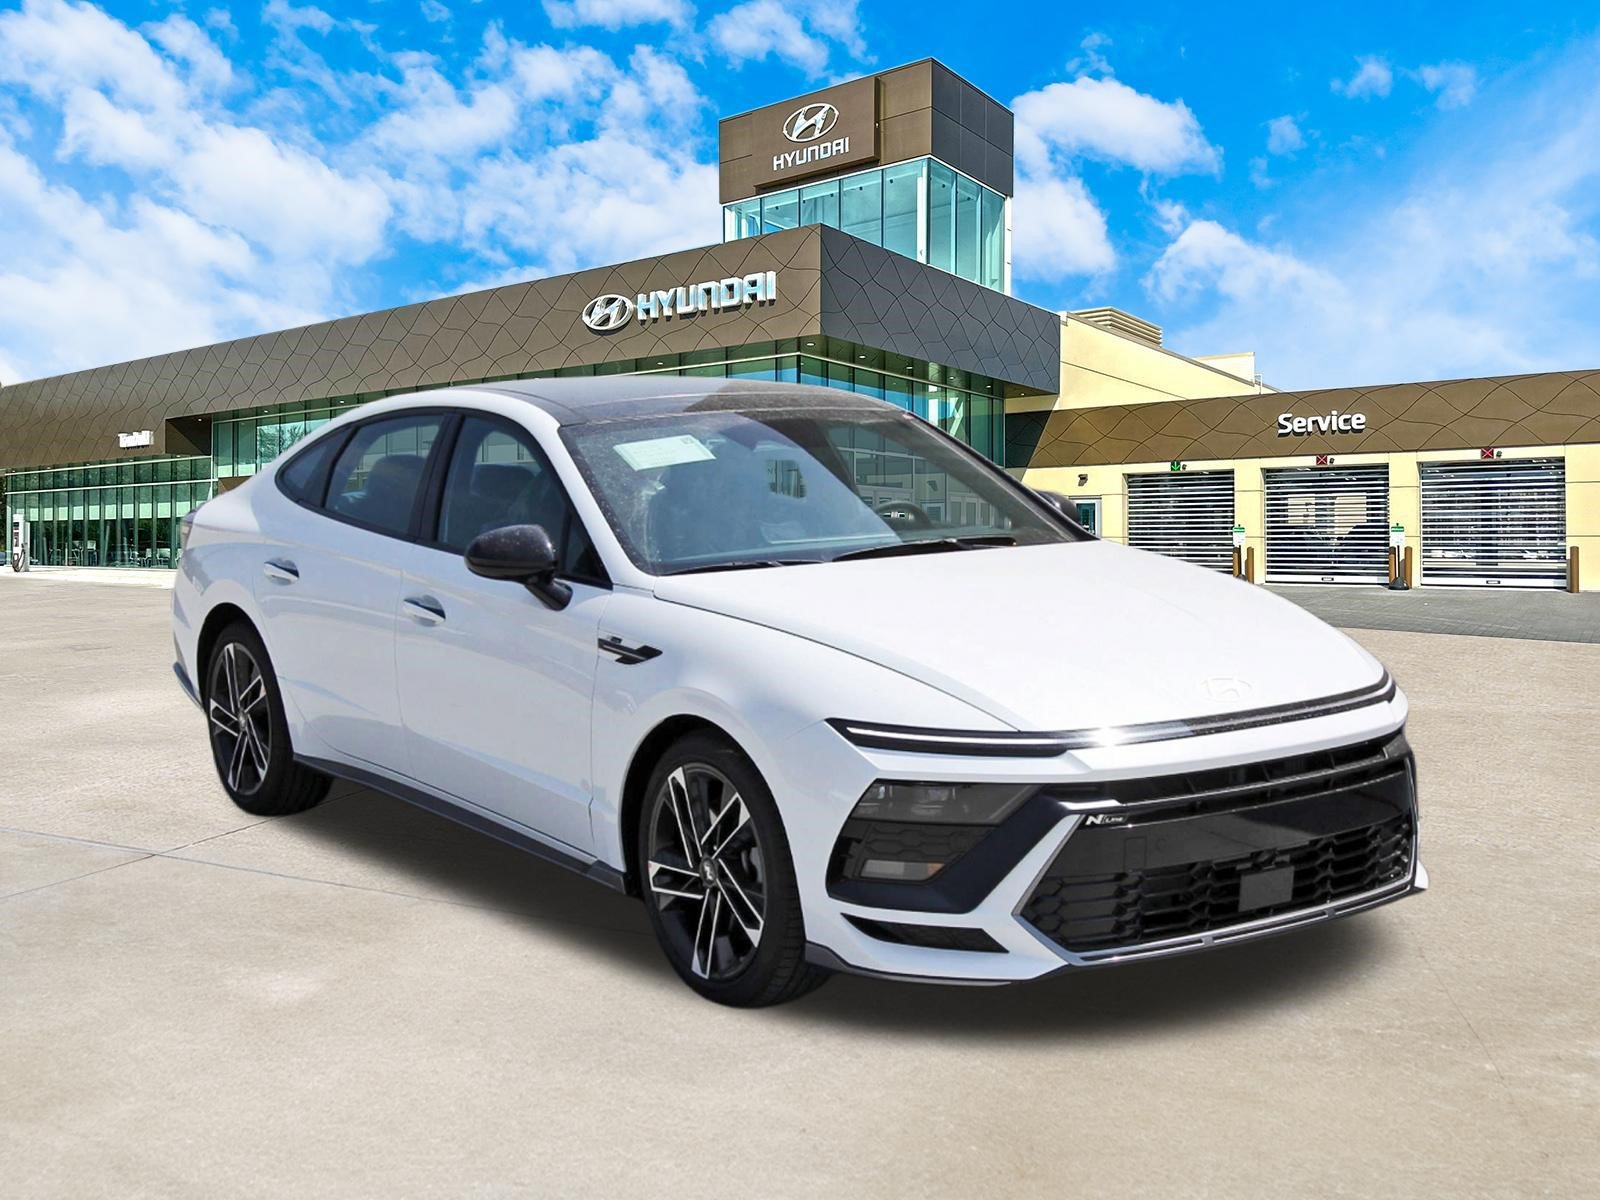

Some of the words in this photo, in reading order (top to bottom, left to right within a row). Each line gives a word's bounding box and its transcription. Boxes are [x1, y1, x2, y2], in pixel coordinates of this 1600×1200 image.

[773, 137, 850, 171] HYUNDAI
[636, 270, 778, 321] HYUNDAI
[1277, 410, 1366, 434] Service
